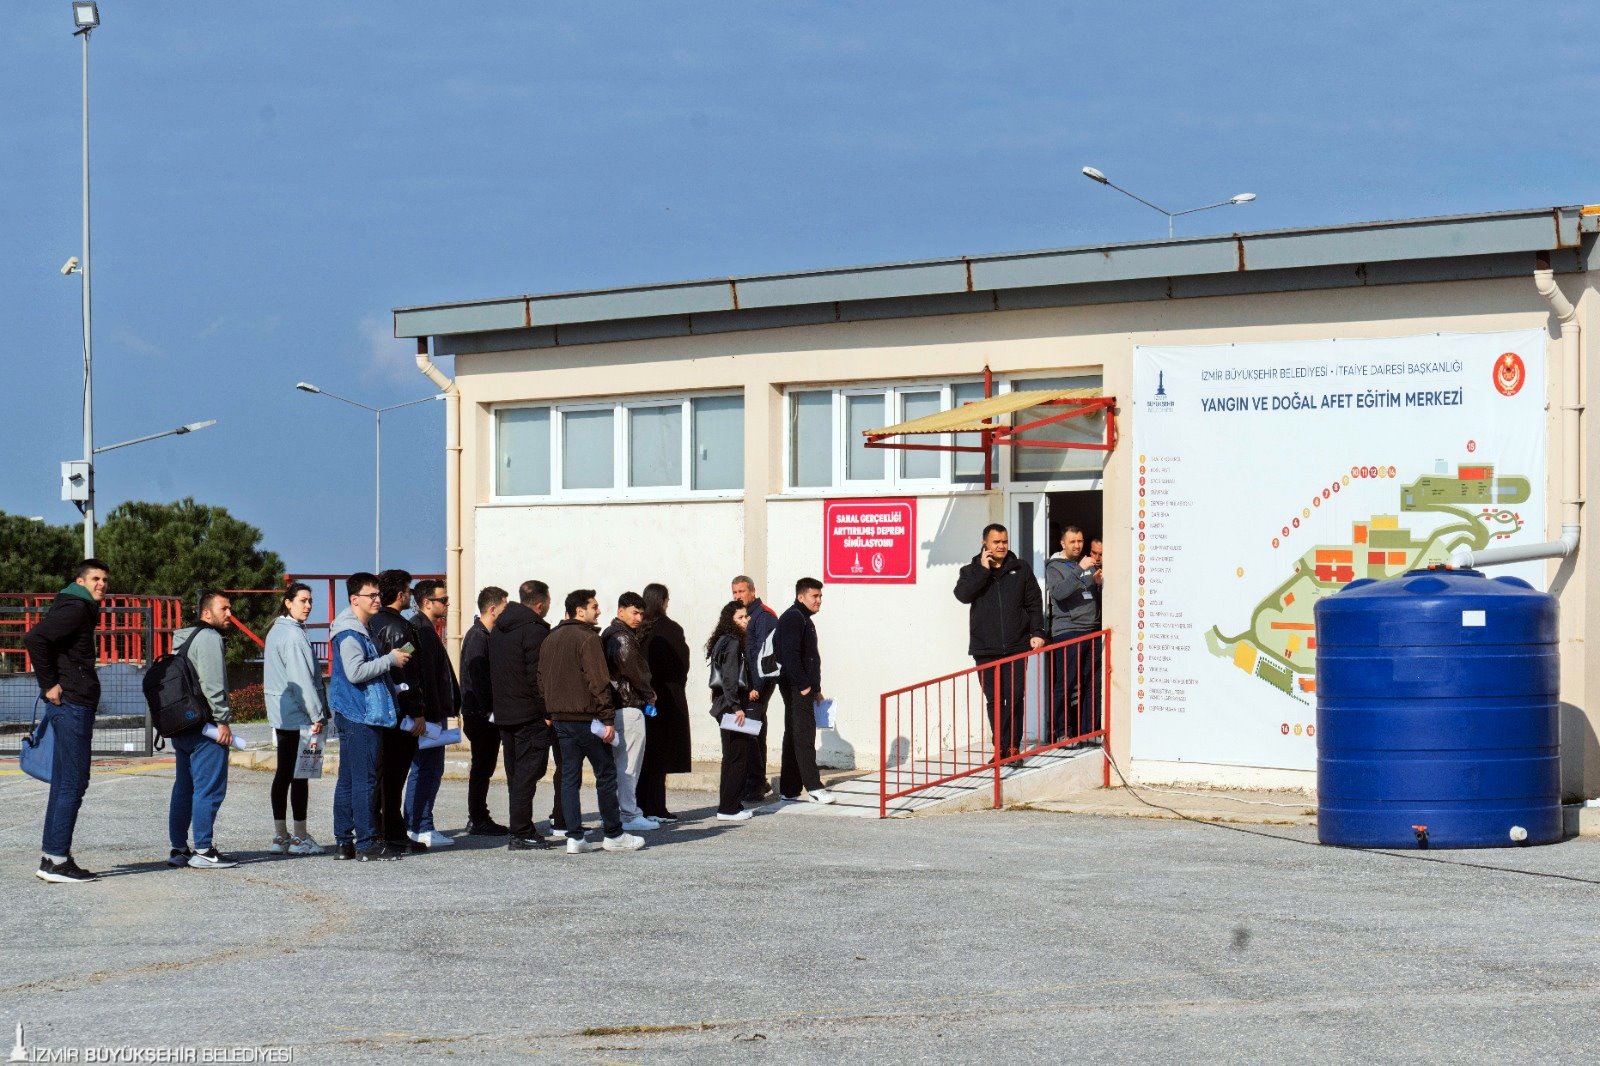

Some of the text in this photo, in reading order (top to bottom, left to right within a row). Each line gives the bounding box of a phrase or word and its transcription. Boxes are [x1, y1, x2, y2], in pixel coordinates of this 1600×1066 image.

[1201, 359, 1463, 381] İZMİR BÜYÜKŞEHİR BELEDİYESİ İTFAİYE DAİRESİ BAŞKANLIĞI
[1201, 386, 1463, 412] YANGIN VE DOĞAL AFET EĞİTİM MERKEZİ
[836, 511, 902, 524] SANAL GERÇEKLİĞİ
[876, 526, 905, 535] DEPREM
[843, 536, 894, 548] SİMÜLASYONU
